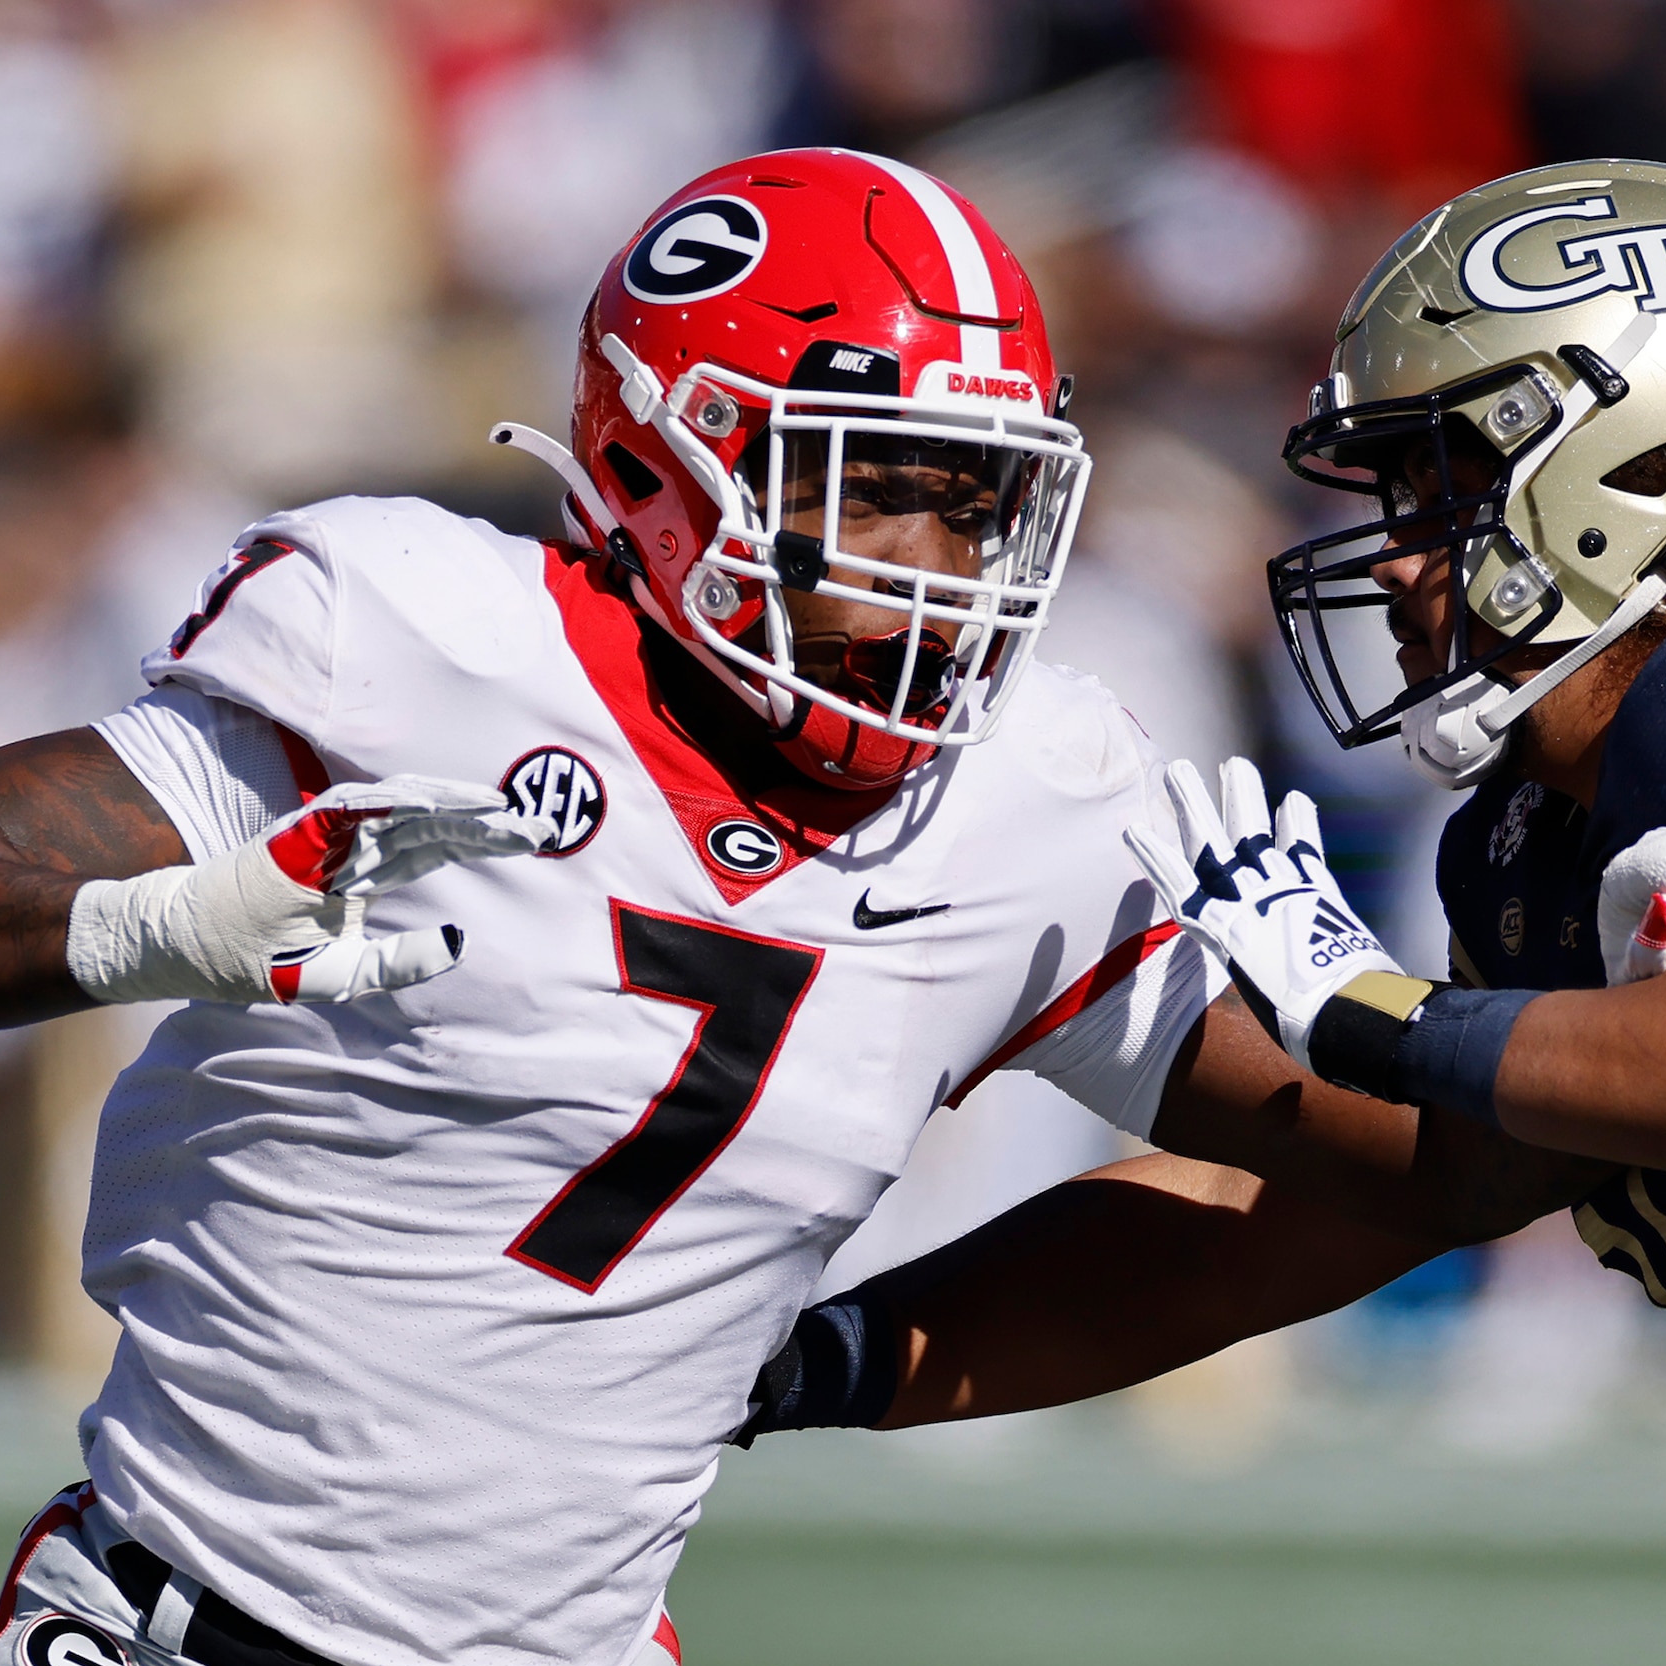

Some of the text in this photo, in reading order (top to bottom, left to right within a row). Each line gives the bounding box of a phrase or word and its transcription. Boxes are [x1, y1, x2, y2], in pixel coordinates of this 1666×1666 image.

[626, 197, 763, 298] G
[829, 349, 874, 374] NIKE
[948, 373, 1033, 401] DAWGS
[507, 753, 599, 850] SEC
[707, 819, 782, 874] G
[1311, 932, 1389, 967] adida
[503, 896, 826, 1295] 7
